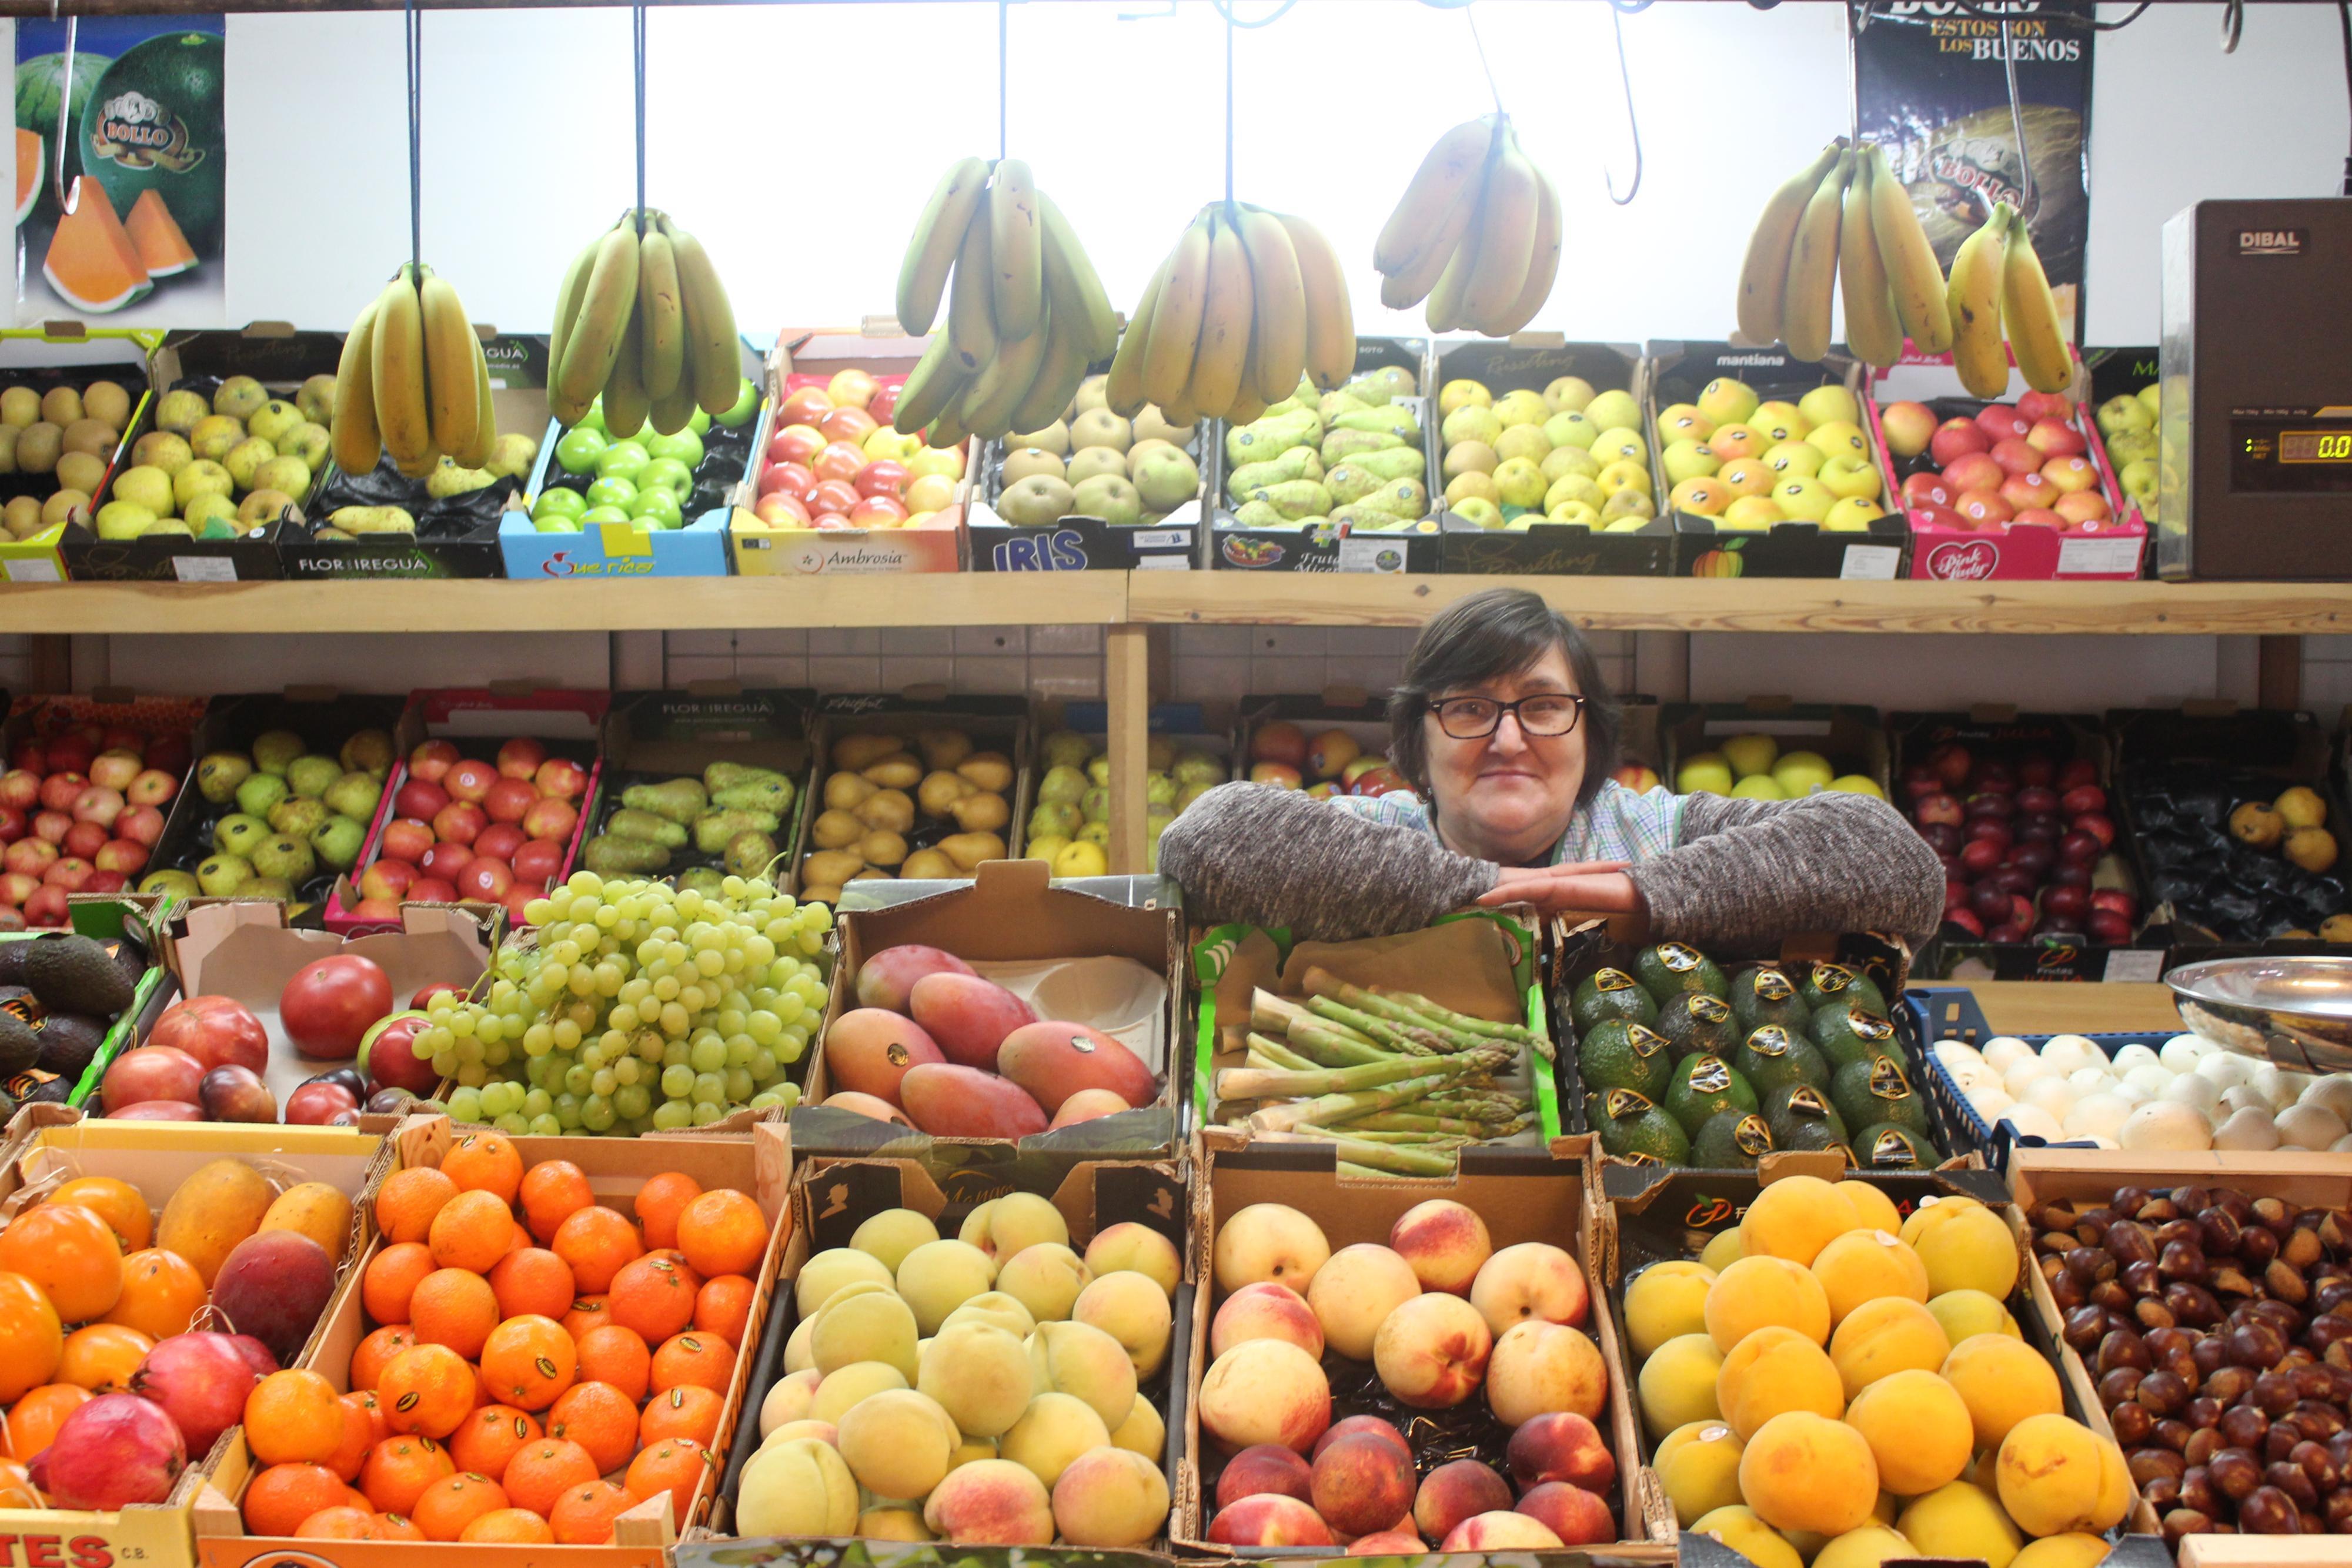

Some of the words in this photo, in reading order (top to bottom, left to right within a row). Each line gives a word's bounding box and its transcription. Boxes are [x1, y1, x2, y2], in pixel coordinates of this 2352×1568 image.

[1930, 19, 1999, 36] ESTOS
[1940, 38, 1973, 52] LOS
[1972, 38, 2080, 61] BUENOS
[107, 121, 169, 146] BOLLO
[2240, 232, 2300, 248] DIBAL
[827, 549, 903, 566] Ambrosia
[993, 529, 1088, 572] IRIS
[299, 559, 344, 571] FLOR
[354, 558, 427, 571] IREGUA
[1939, 547, 1980, 574] Pink
[663, 704, 700, 714] FLOR
[709, 704, 770, 714] IREGUA
[121, 1547, 149, 1559] C.B.
